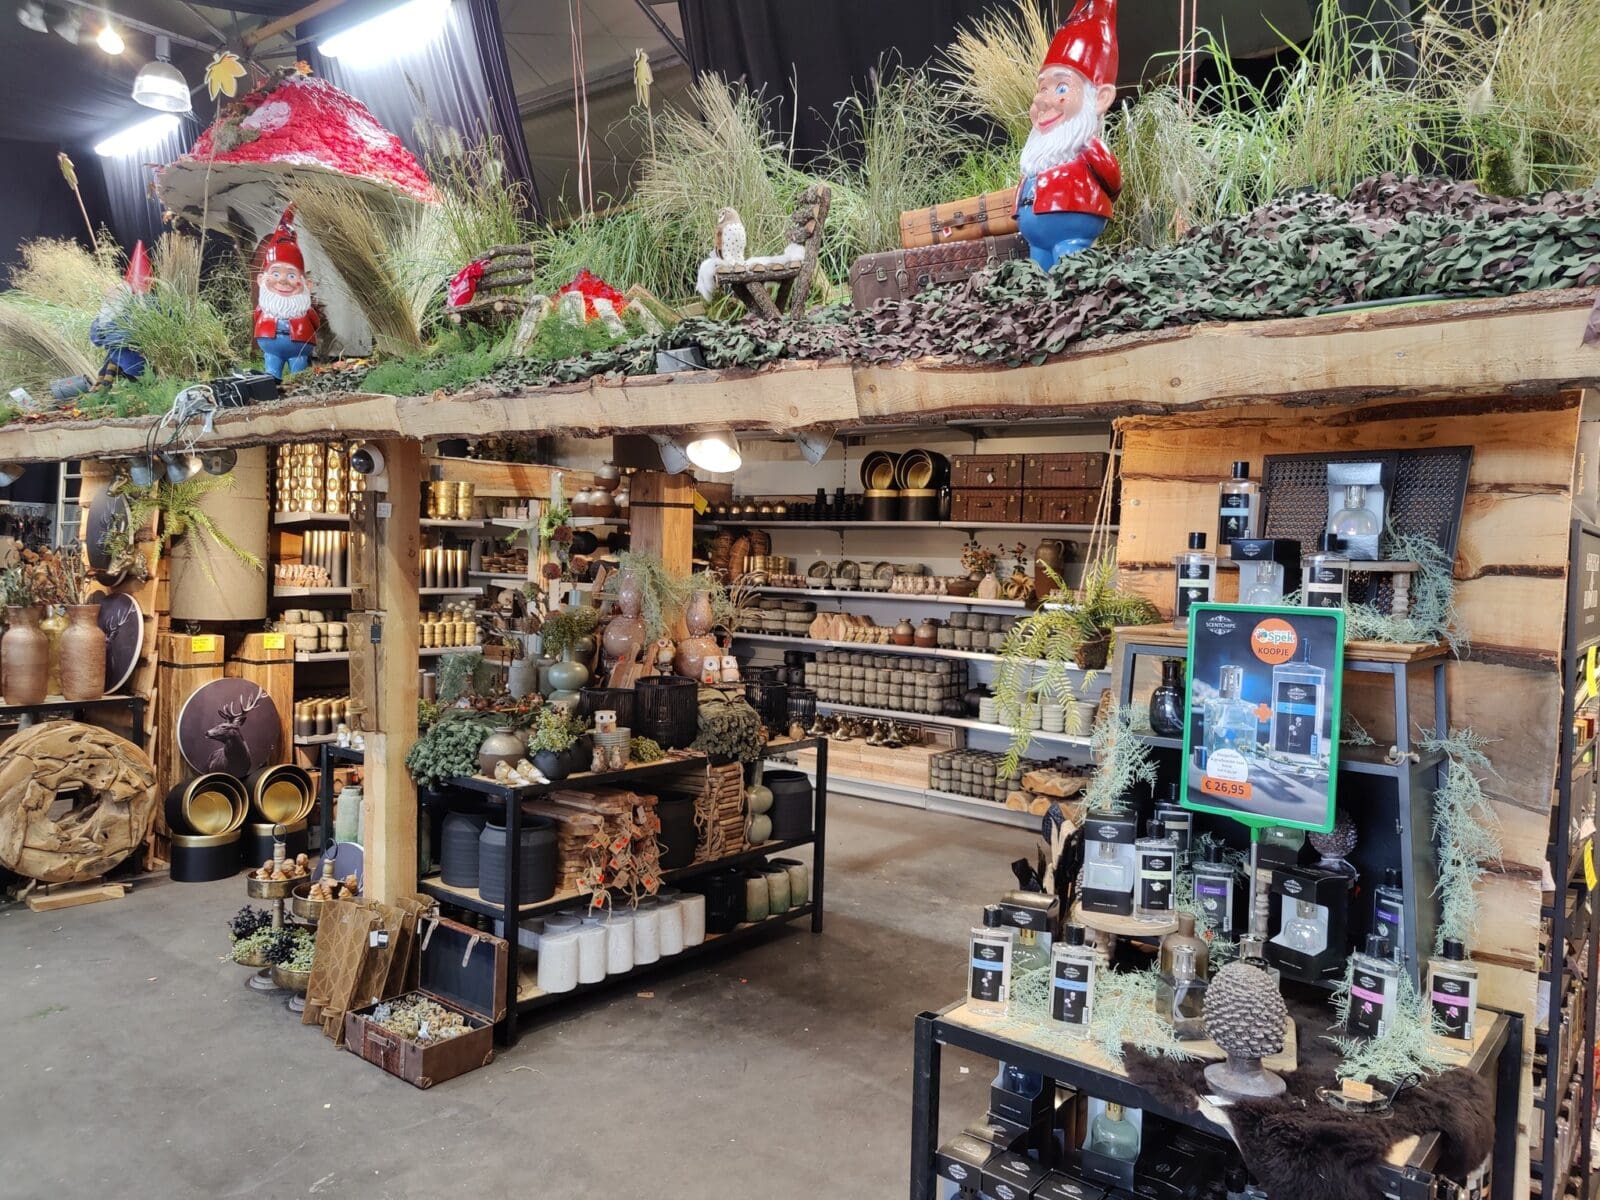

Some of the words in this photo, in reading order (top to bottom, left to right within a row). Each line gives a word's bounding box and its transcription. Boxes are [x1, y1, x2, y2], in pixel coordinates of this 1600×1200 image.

[1269, 631, 1293, 643] Spek
[1258, 647, 1289, 656] KOOPJE
[1205, 780, 1212, 790] €
[1214, 781, 1245, 795] 26,95
